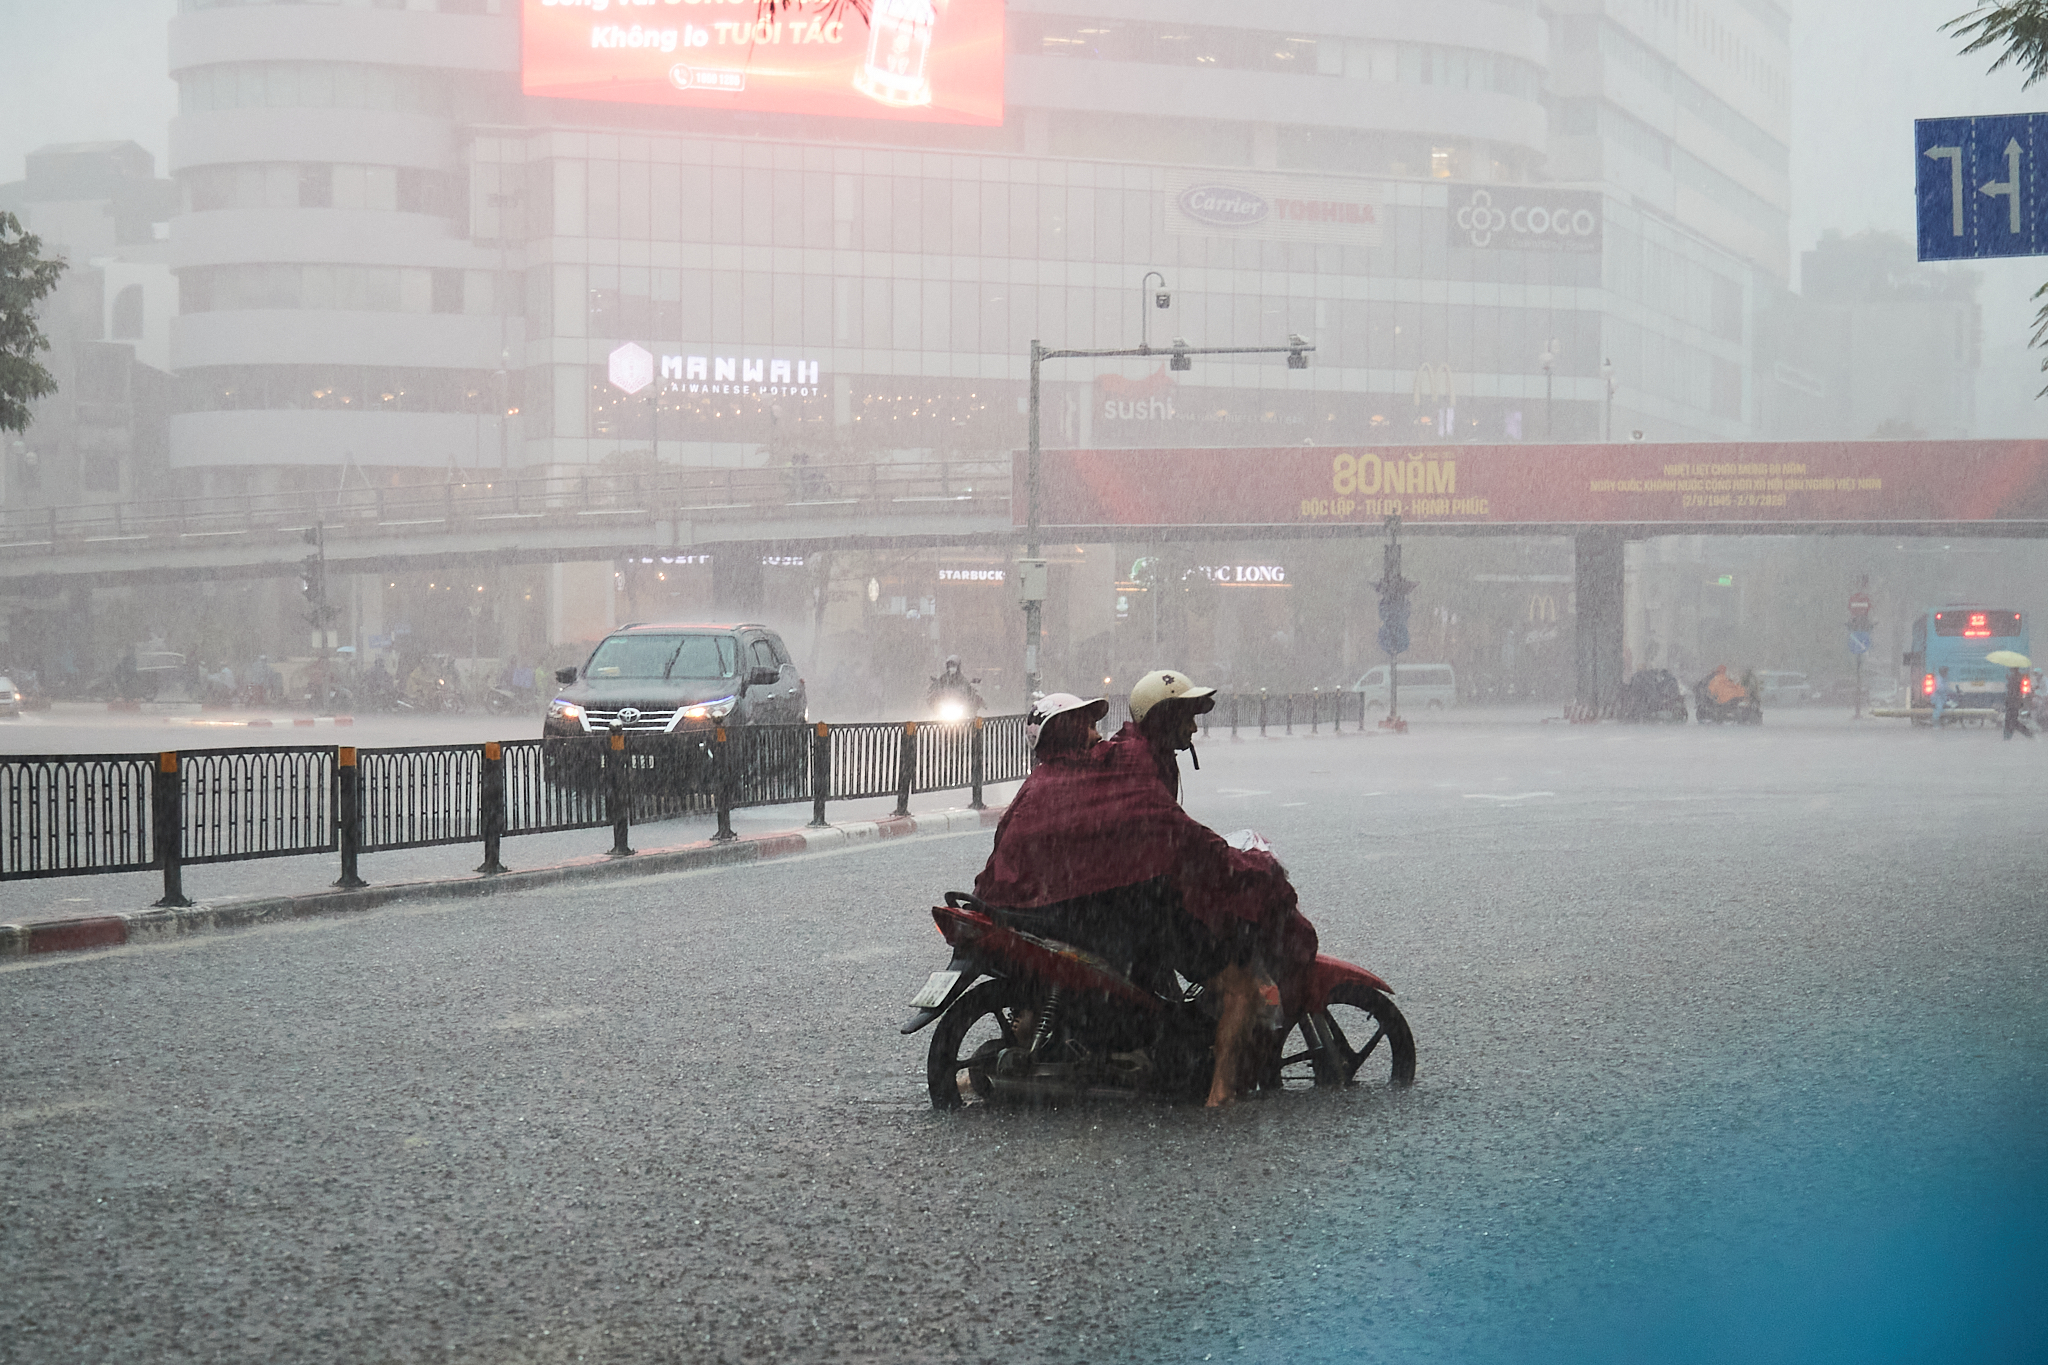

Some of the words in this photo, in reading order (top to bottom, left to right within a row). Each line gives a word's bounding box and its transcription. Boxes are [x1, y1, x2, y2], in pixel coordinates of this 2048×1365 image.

[591, 24, 678, 52] Không
[684, 24, 708, 47] lo
[714, 14, 782, 45] TUỔI
[789, 16, 844, 45] TÁC
[1190, 191, 1263, 215] Carrier
[1275, 198, 1375, 224] TOSHIBA
[661, 354, 819, 384] MANWAH
[1104, 396, 1174, 420] sushi
[1452, 496, 1490, 515] PHÚC
[939, 569, 1006, 581] STARBUCK
[1236, 565, 1286, 582] LONG
